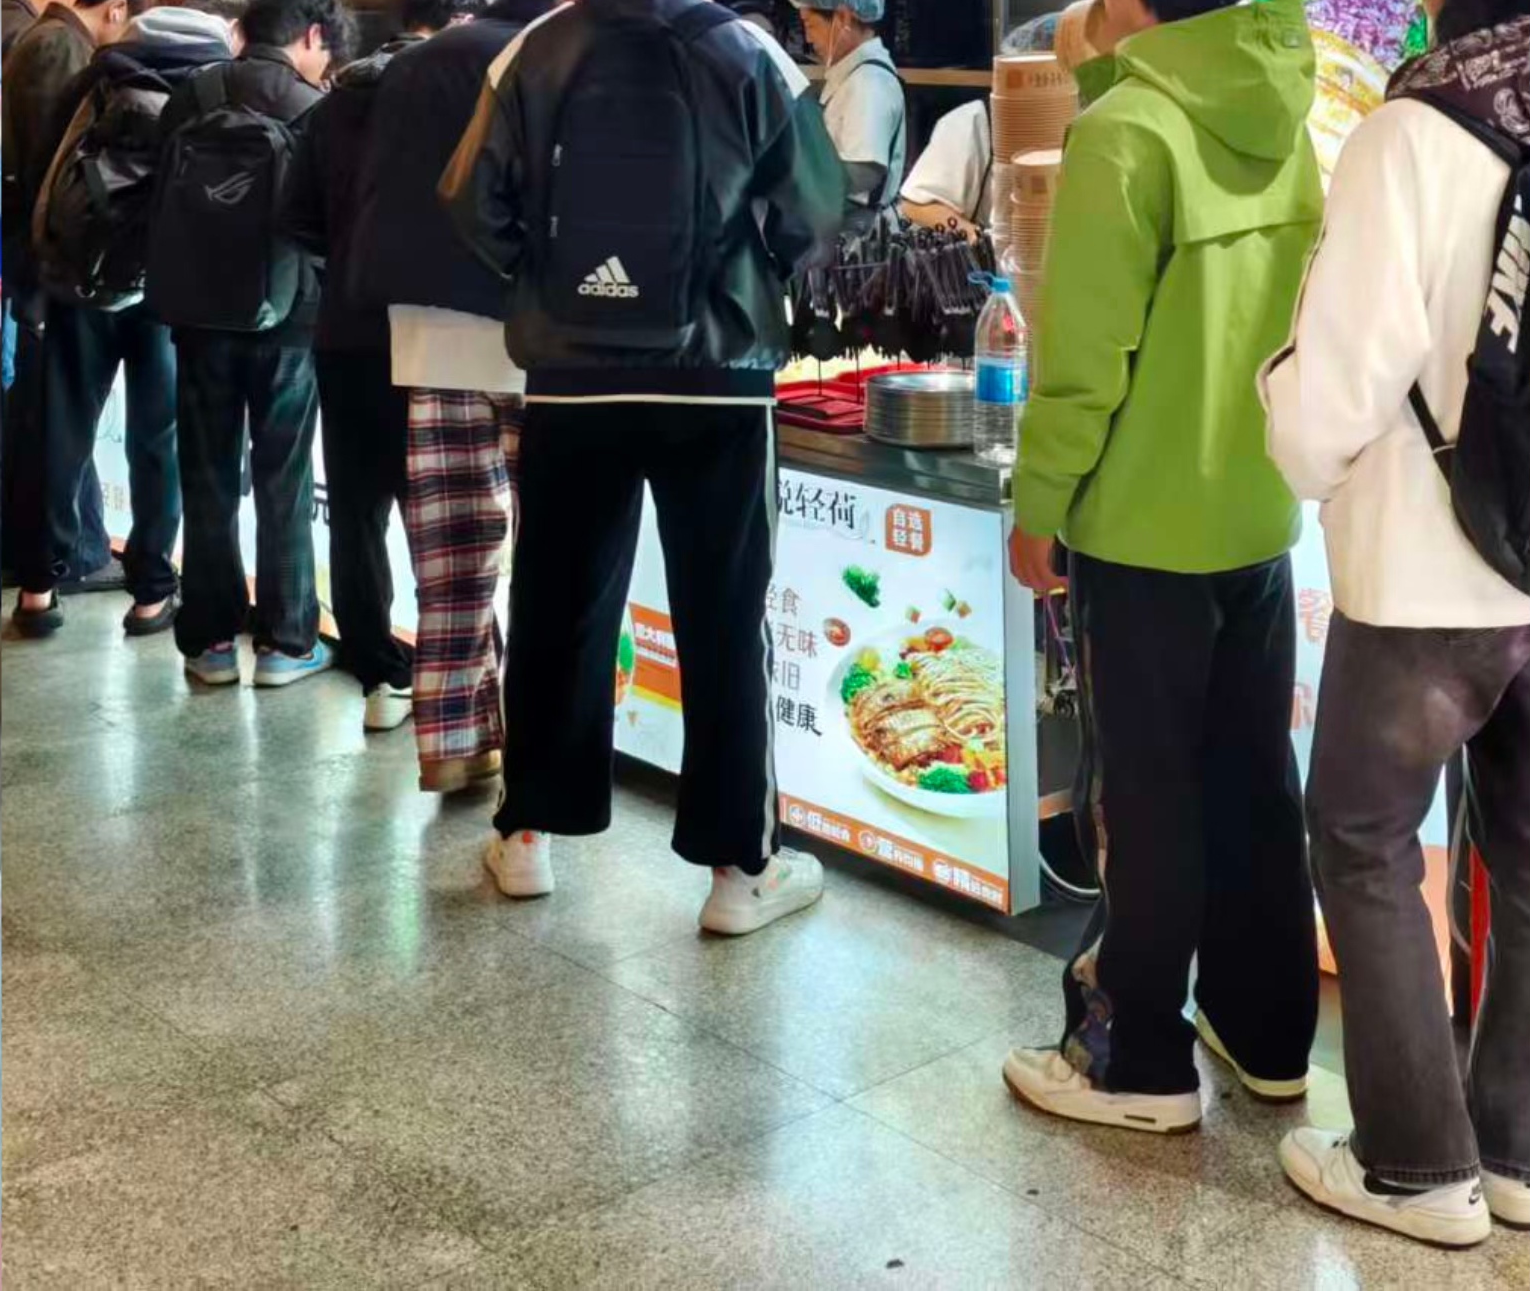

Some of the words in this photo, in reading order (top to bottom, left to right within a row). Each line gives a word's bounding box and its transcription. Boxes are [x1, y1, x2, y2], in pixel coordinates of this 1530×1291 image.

[577, 280, 639, 298] adidas
[772, 623, 818, 658] 无味
[776, 695, 823, 737] 健康
